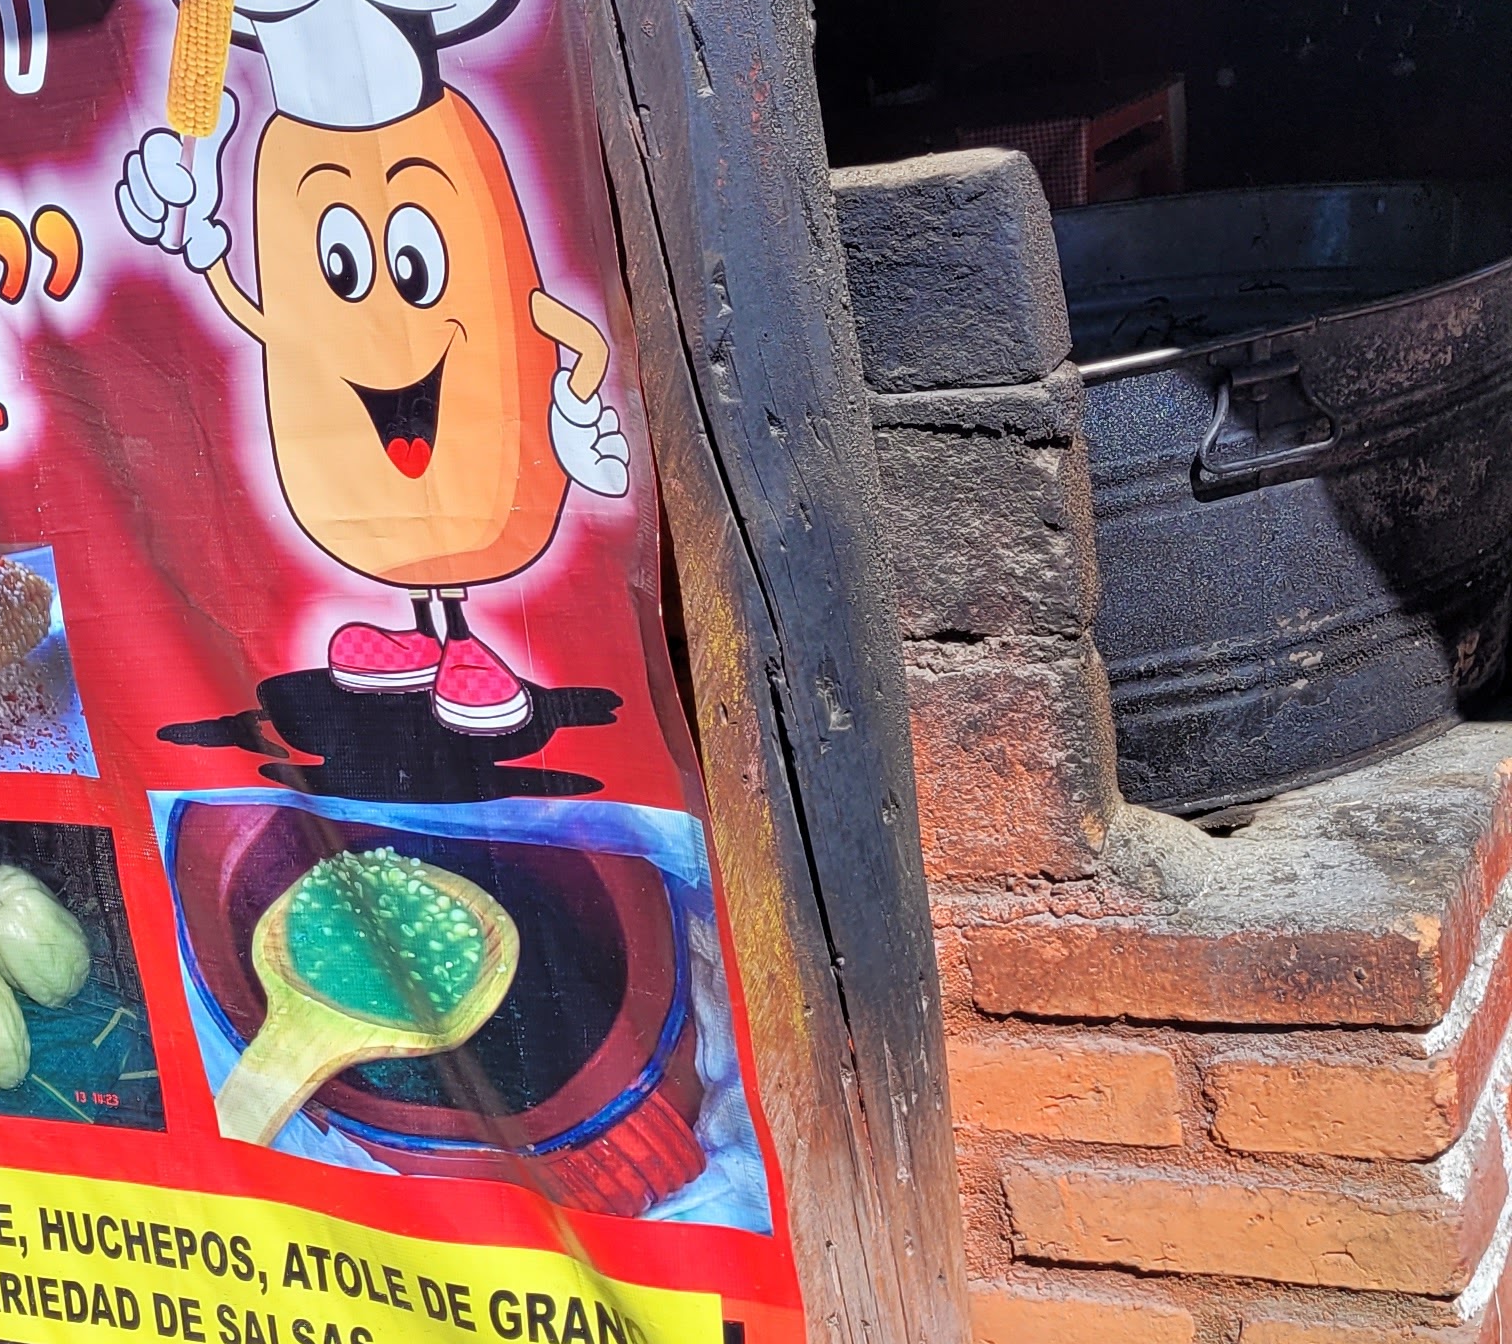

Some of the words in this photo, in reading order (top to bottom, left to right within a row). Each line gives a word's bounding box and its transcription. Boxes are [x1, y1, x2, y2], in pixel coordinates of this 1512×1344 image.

[40, 1206, 267, 1294] HUCHEPOS,
[283, 1241, 412, 1311] ATOLE
[417, 1275, 478, 1333] DE
[153, 1291, 206, 1344] DE
